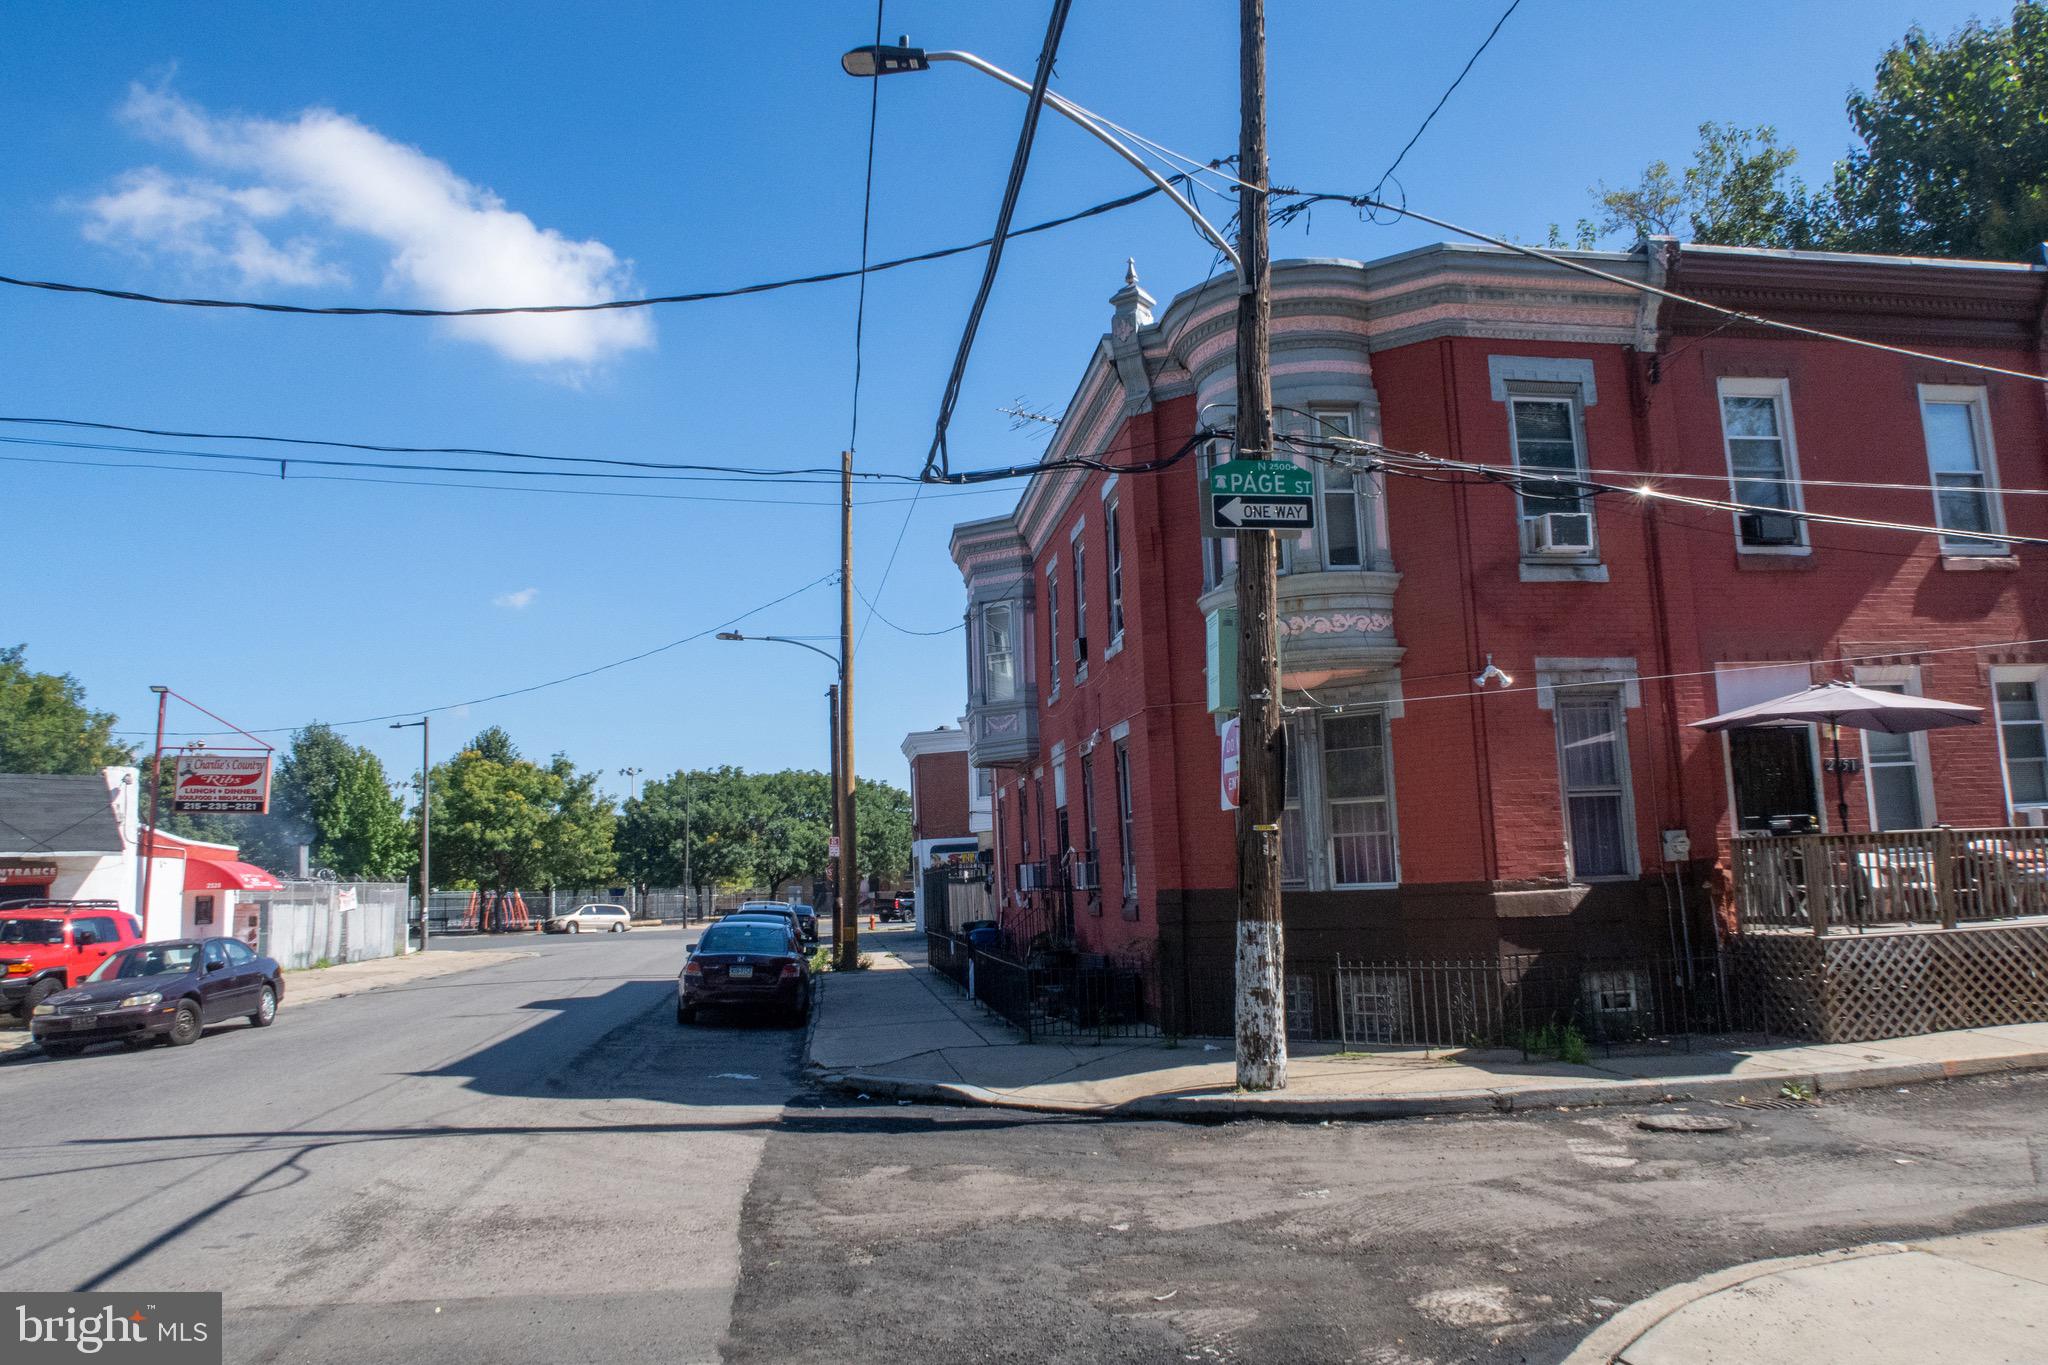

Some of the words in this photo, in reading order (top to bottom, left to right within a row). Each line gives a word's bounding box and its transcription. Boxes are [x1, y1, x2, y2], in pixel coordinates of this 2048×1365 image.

[1257, 462, 1266, 471] N
[1269, 463, 1291, 471] 2500
[1230, 473, 1287, 493] PAGE
[1294, 480, 1312, 494] ST
[1243, 505, 1271, 519] ONE
[1274, 505, 1303, 519] WAY
[194, 759, 231, 770] Charlie's
[232, 759, 264, 772] Country
[1826, 759, 1857, 771] 251
[200, 774, 242, 787] Ribs
[183, 802, 257, 811] 215-235-2121
